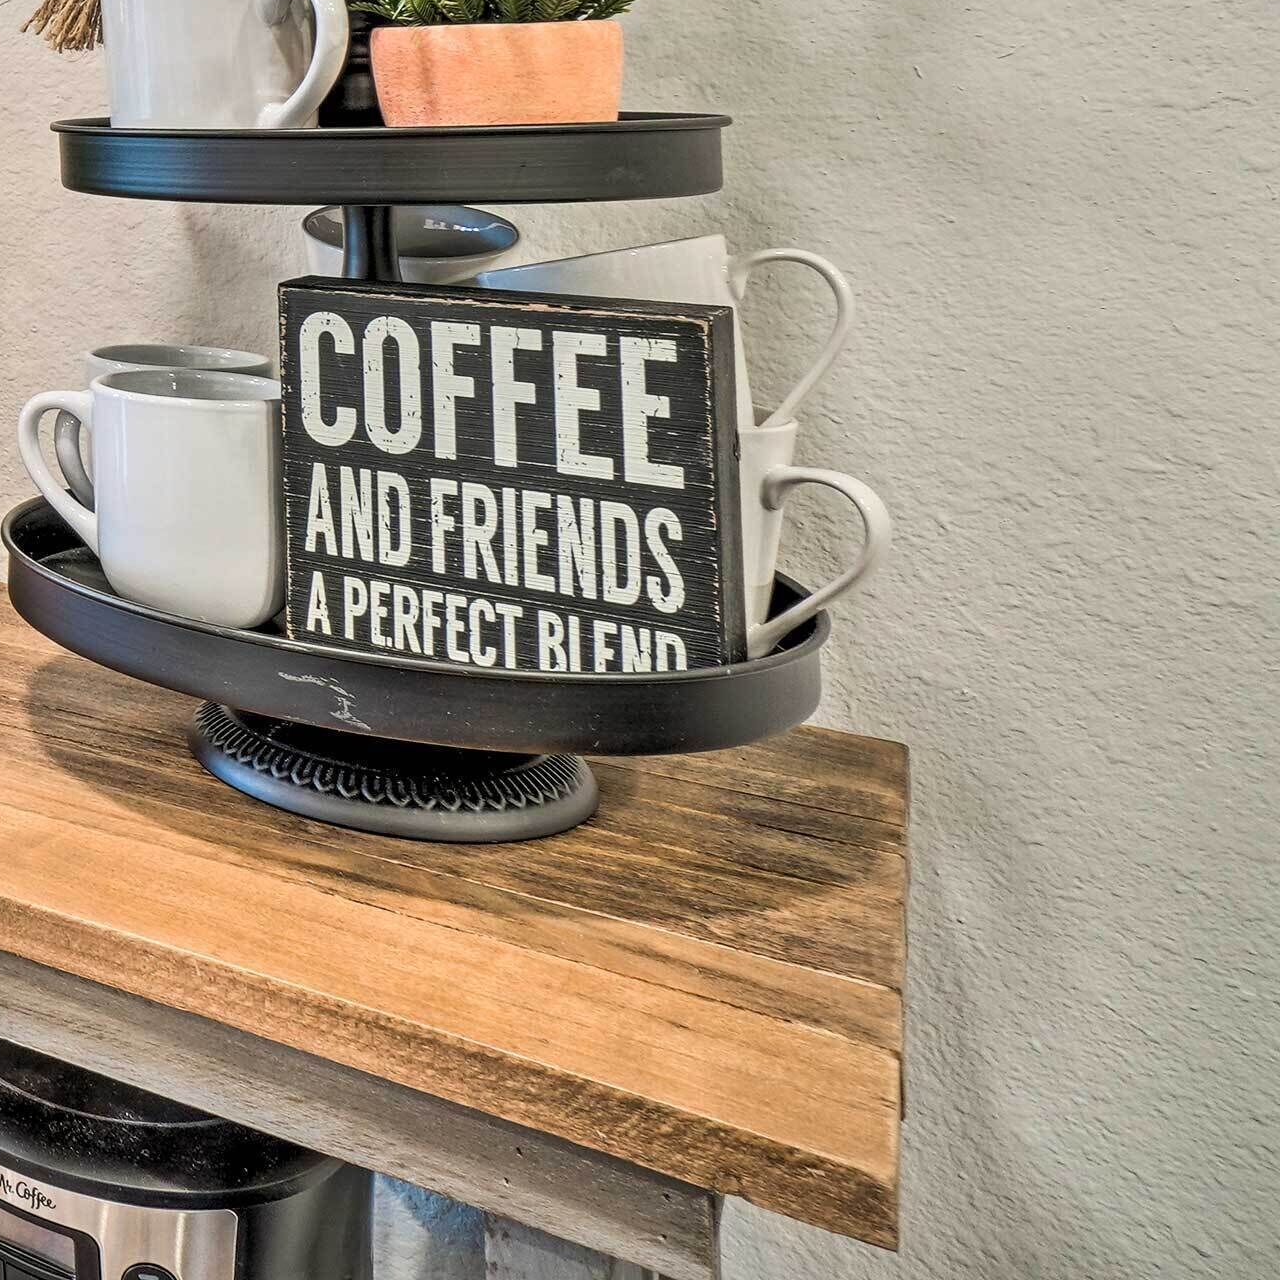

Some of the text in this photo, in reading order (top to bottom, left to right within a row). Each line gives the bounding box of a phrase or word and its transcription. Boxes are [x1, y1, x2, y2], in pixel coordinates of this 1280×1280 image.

[298, 310, 686, 490] COFFEE
[304, 462, 686, 614] AND FRIENDS
[306, 571, 333, 635] A
[344, 576, 524, 670] PERFECT
[15, 1181, 57, 1210] Coffee
